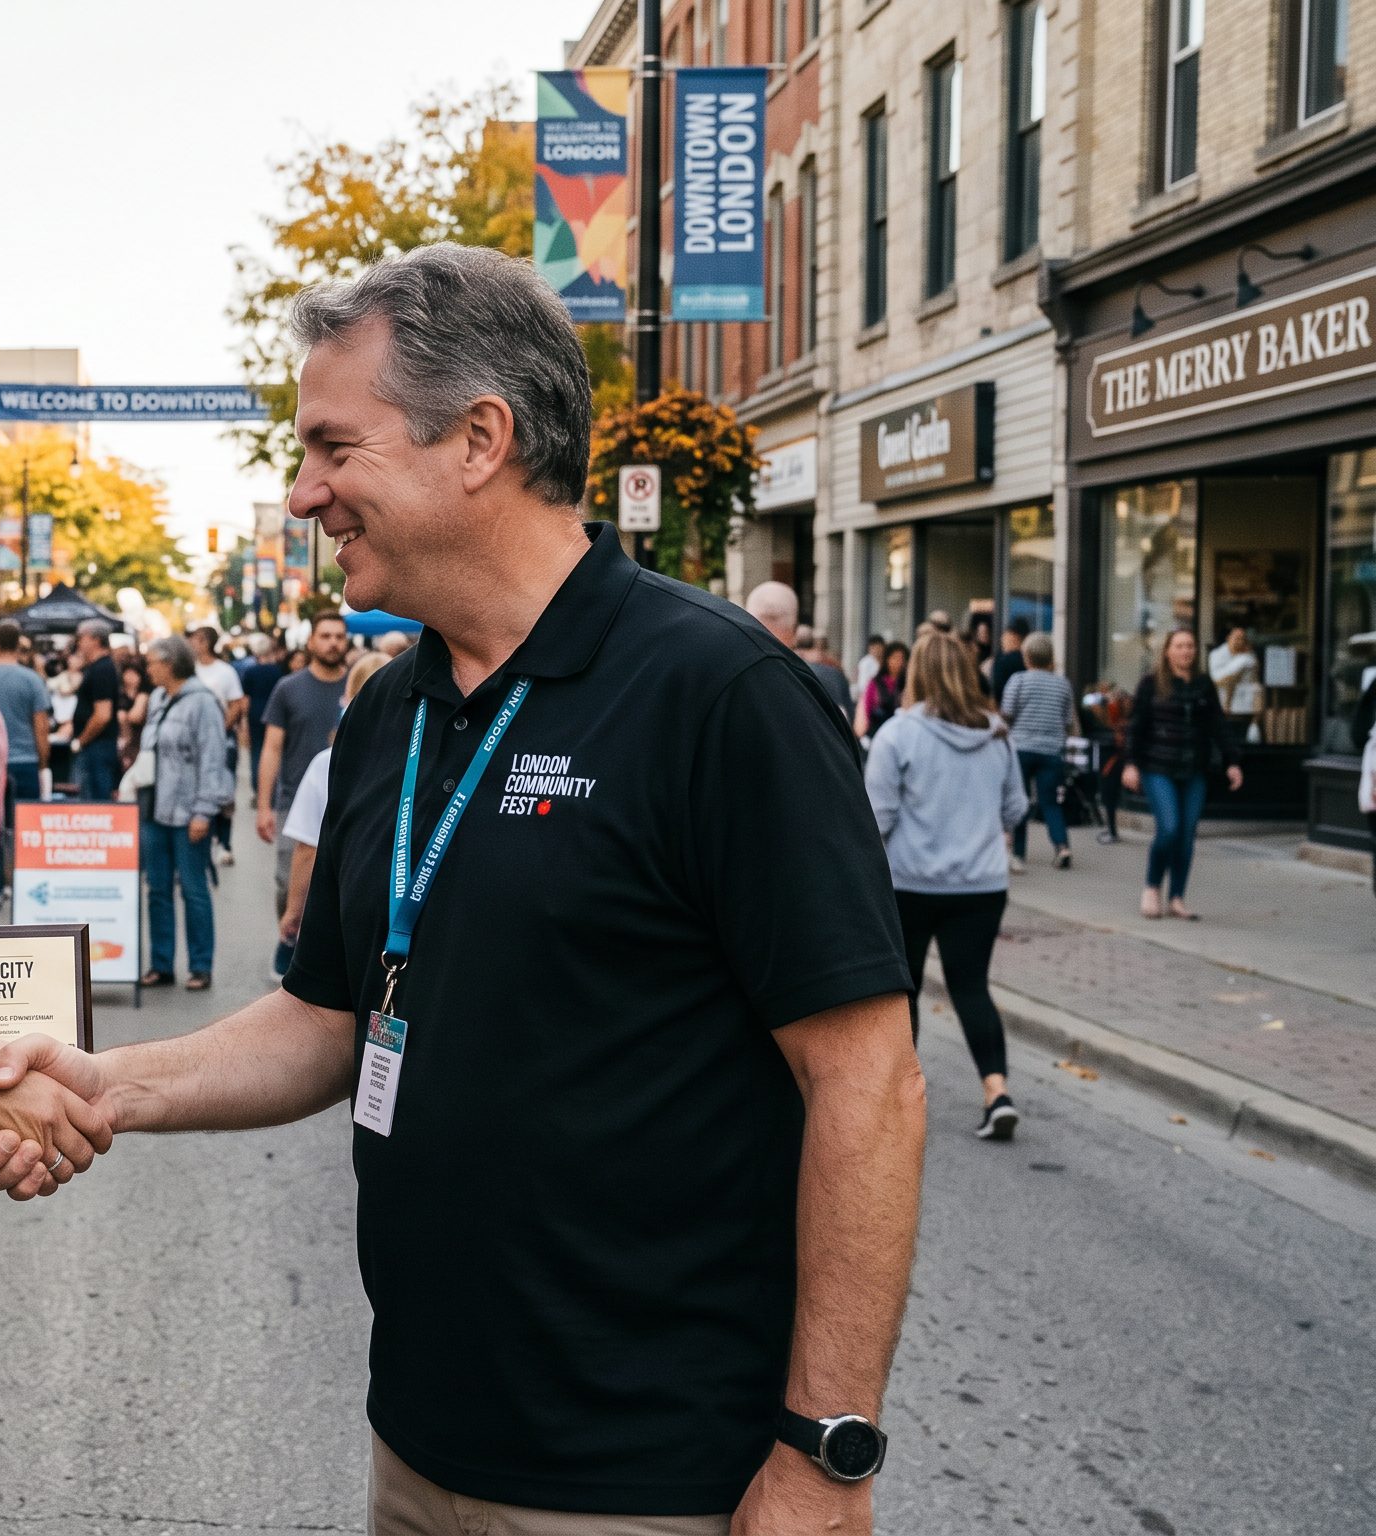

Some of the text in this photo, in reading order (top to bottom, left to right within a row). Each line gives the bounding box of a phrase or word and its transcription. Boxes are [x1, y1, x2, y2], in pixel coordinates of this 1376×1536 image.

[544, 144, 621, 161] LONDON
[684, 93, 717, 254] DOWNTOWN
[717, 92, 757, 252] LONDON
[1100, 296, 1372, 415] THE MERRY BAKER
[0, 390, 98, 411] WELCOME
[100, 391, 129, 411] TO
[130, 391, 252, 412] DOWNTOWN
[511, 753, 571, 775] LONDON
[505, 774, 596, 798] COMMUNITY
[499, 795, 538, 815] FEST
[40, 813, 113, 831] WELCOME
[21, 831, 134, 849] TO DOWNTOWN
[45, 849, 108, 865] LONDON
[0, 960, 34, 979] CITY
